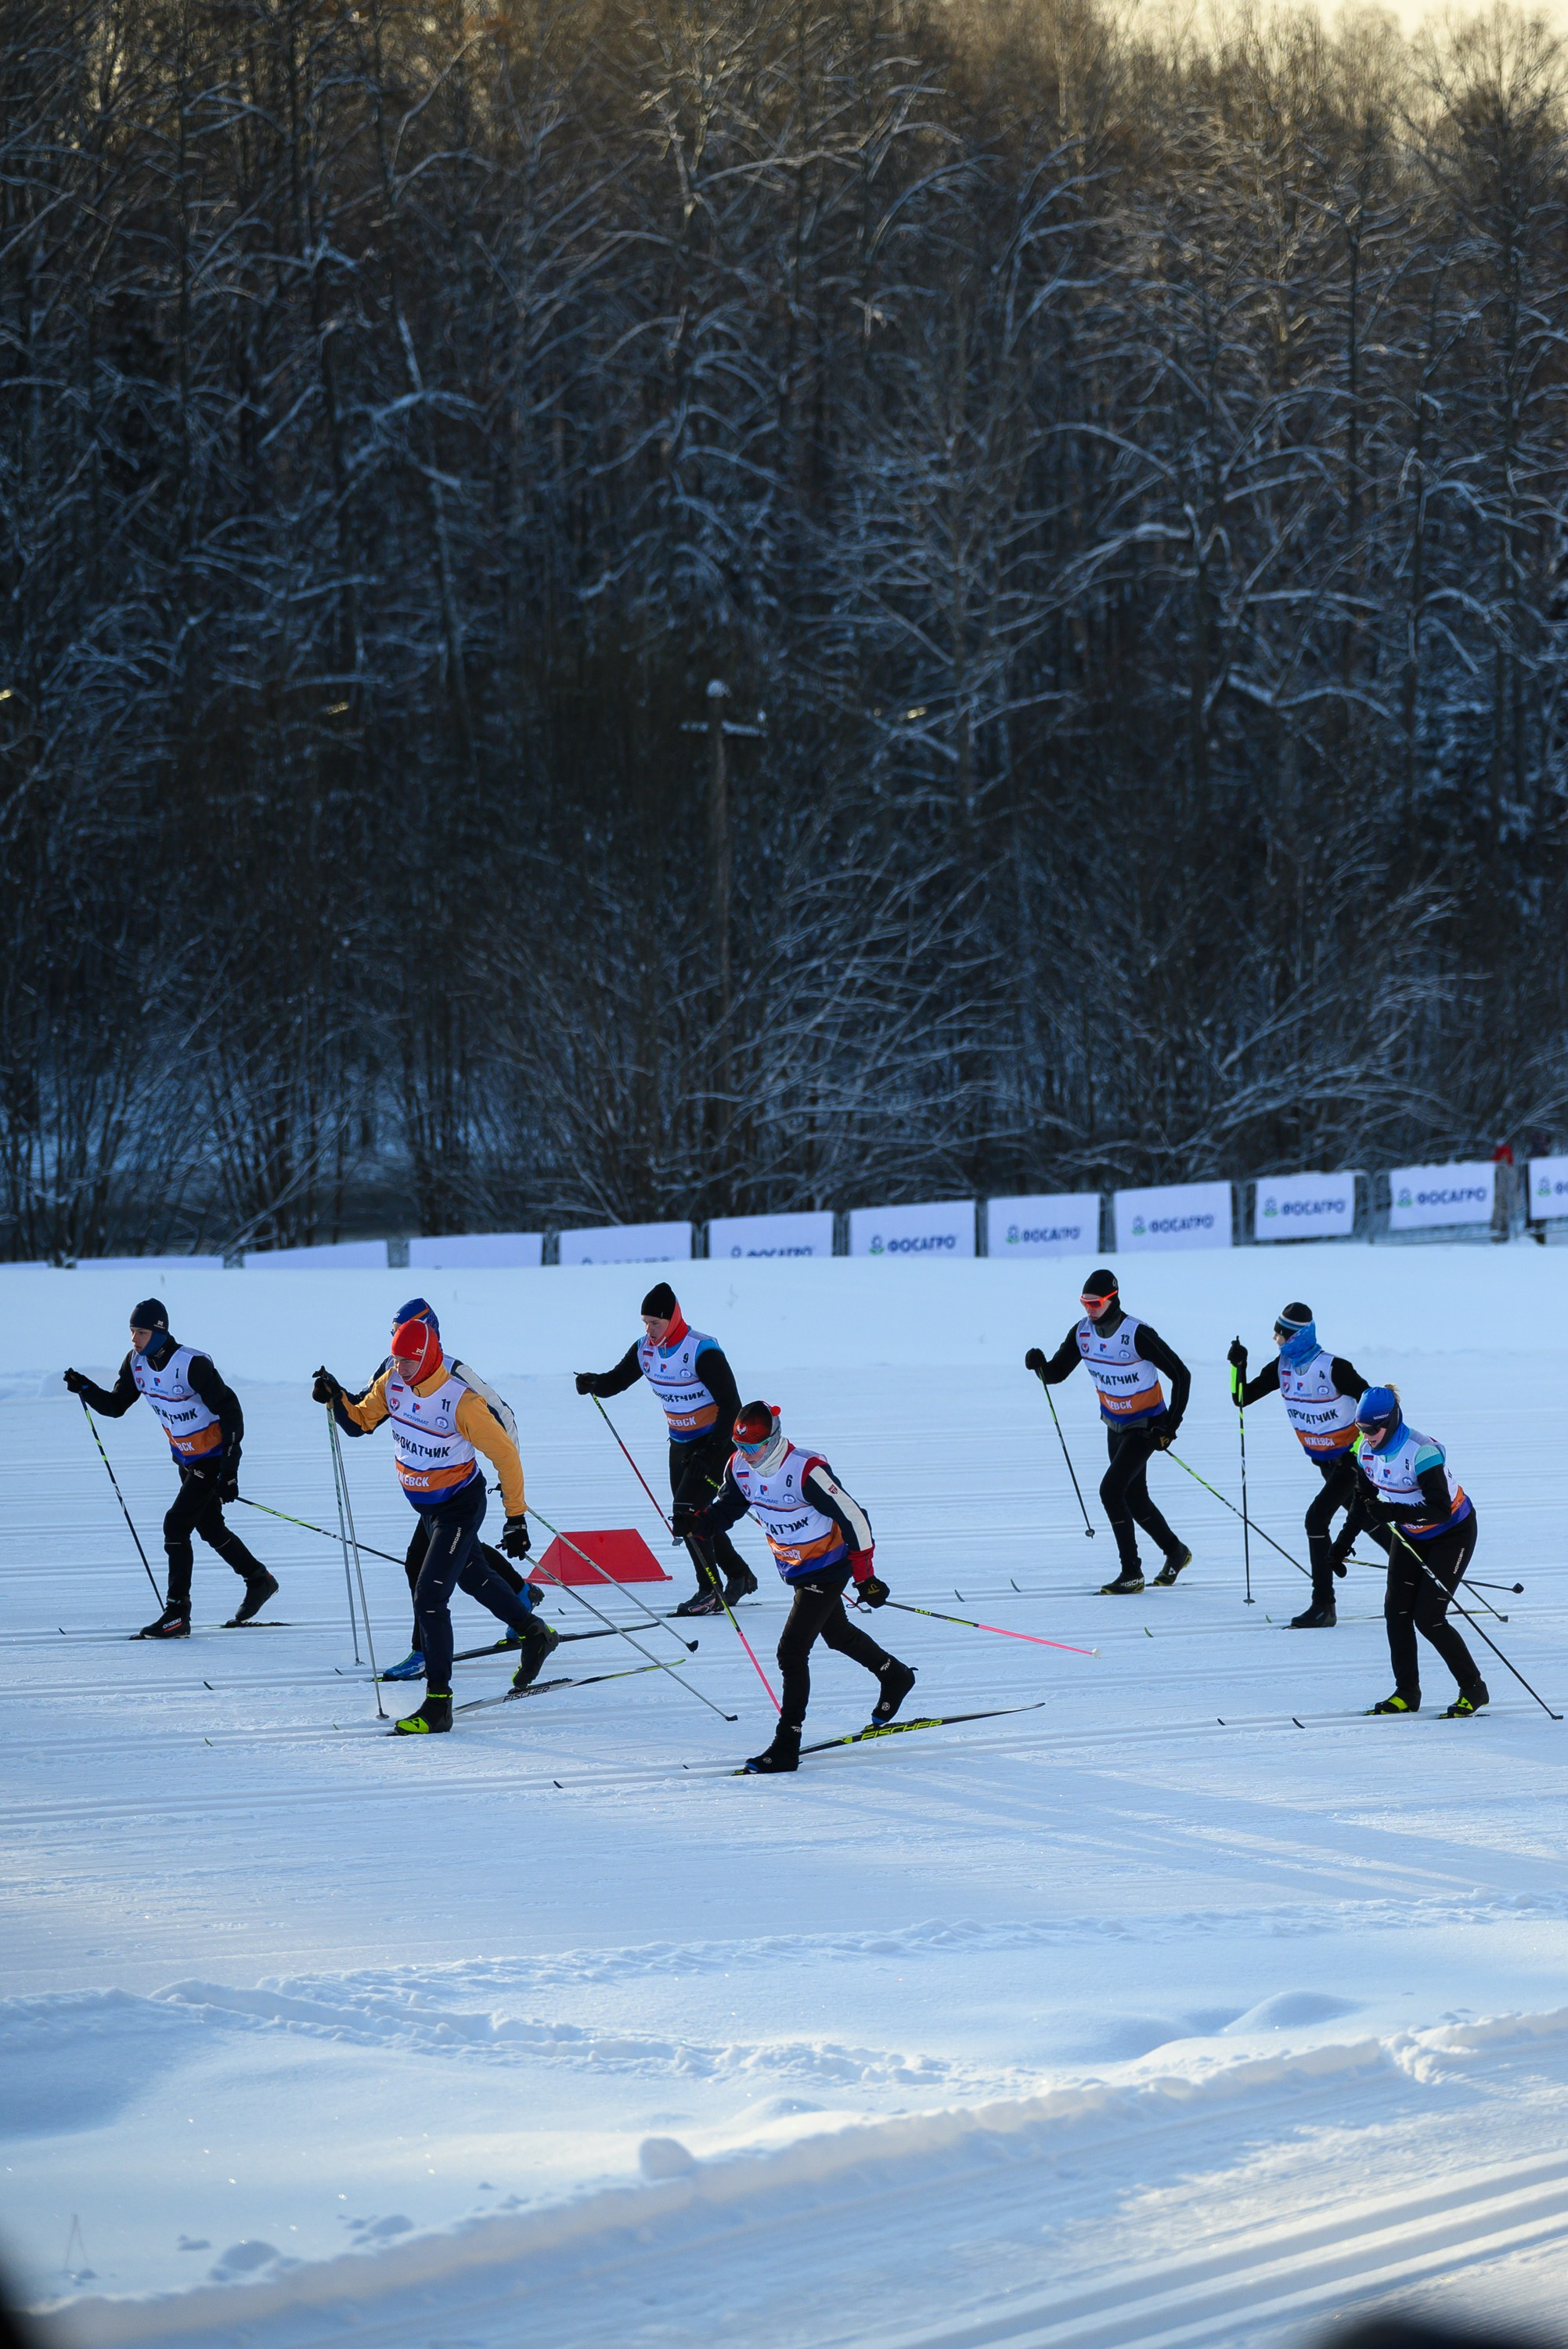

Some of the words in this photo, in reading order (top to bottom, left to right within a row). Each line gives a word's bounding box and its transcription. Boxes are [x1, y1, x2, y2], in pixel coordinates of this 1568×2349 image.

[1417, 1188, 1486, 1204] ФОСАГРО
[1281, 1200, 1346, 1215] ФОСАГРО
[1148, 1214, 1214, 1232] ФОСАГРО
[1021, 1226, 1080, 1243] ФОСАГРО
[887, 1235, 956, 1252] ФОСАГРО
[1120, 1334, 1130, 1345] 13
[683, 1352, 689, 1363] 9
[175, 1368, 179, 1378] 1
[1319, 1370, 1325, 1379] 4
[442, 1398, 451, 1412] 11
[1405, 1459, 1410, 1470] 5
[786, 1474, 793, 1488] 6
[449, 1527, 462, 1554] NORDSKI
[1453, 1547, 1465, 1574] NORDSKI
[1120, 1577, 1144, 1587] FISCHE
[503, 1686, 550, 1702] FISCHER
[861, 1719, 943, 1741] FISCHER
